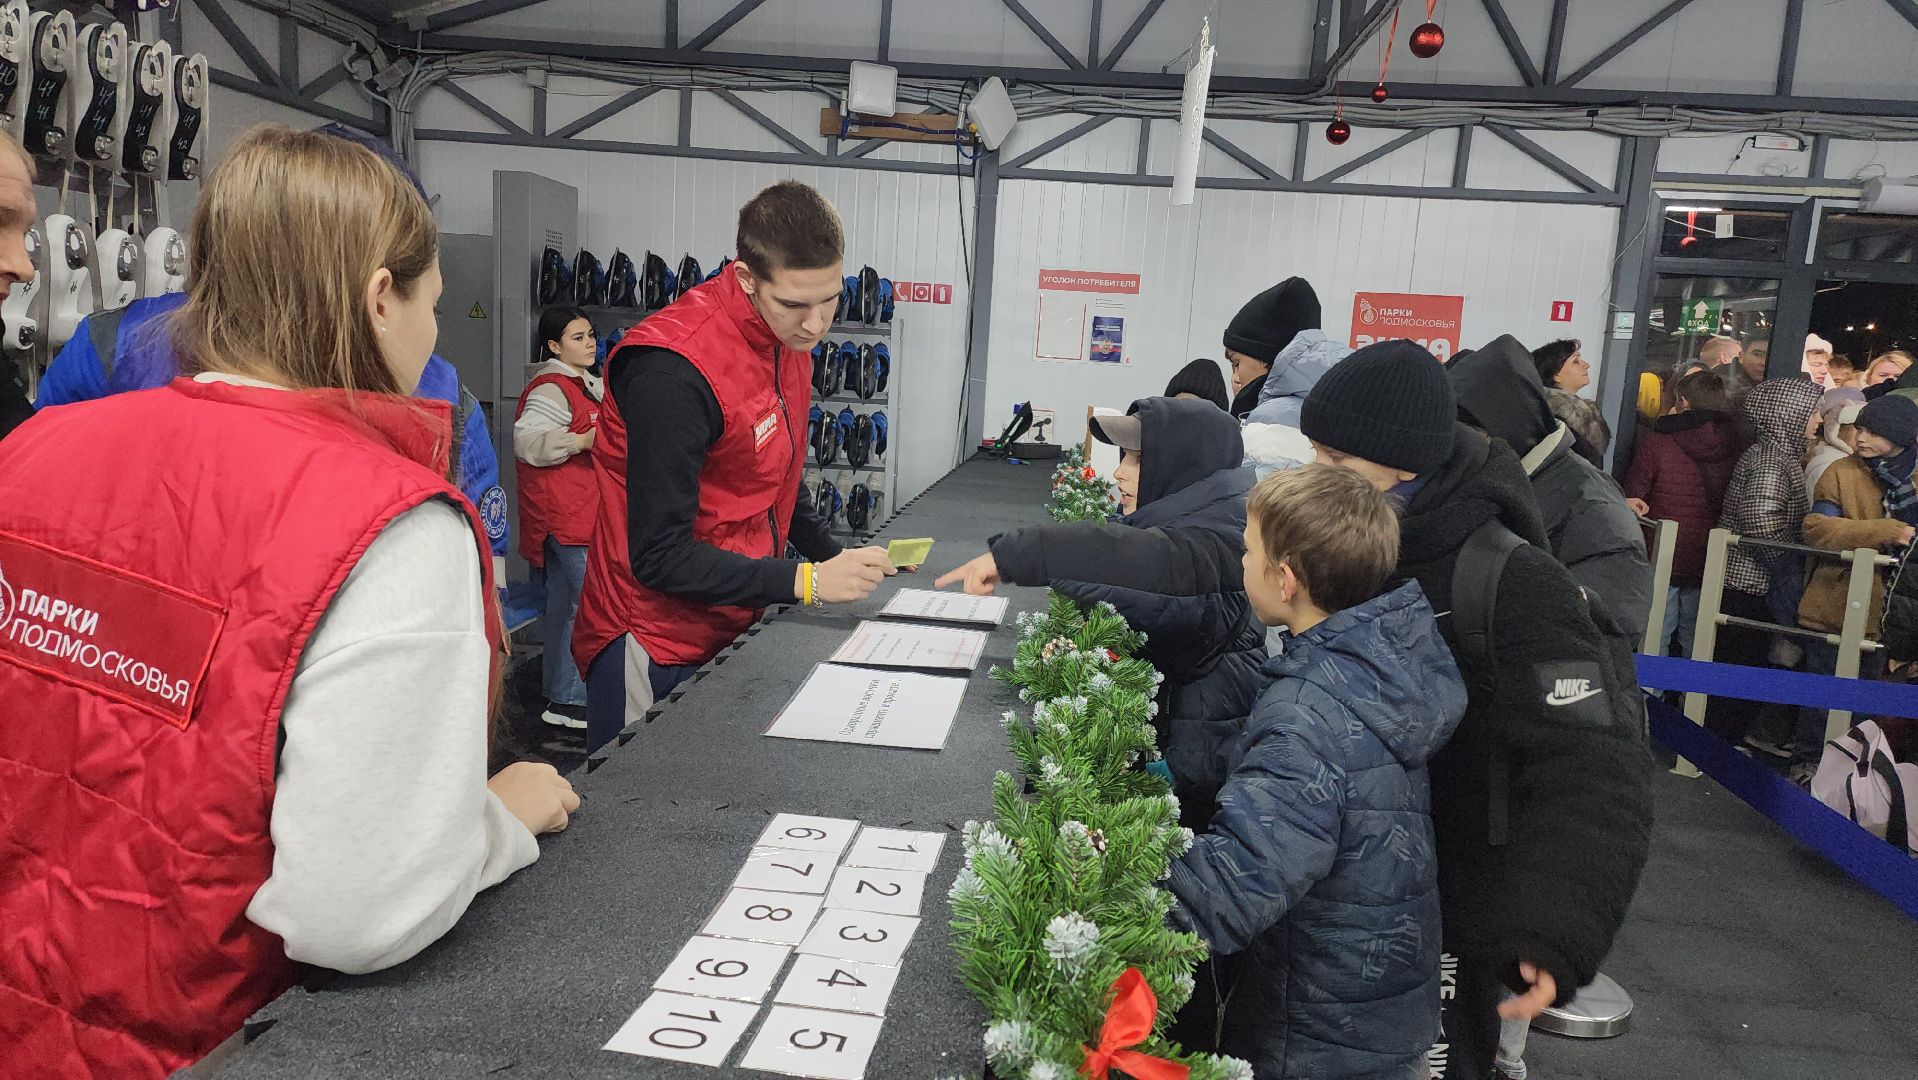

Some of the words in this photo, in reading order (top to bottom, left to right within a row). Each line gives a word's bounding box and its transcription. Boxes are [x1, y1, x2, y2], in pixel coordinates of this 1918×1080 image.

[1042, 275, 1077, 285] УГОЛОК
[1077, 278, 1137, 288] ПОТРЕБИТЕЛЯ
[1379, 308, 1413, 317] ПАРКИ
[1379, 317, 1456, 329] ПОДМОСКОВЬЯ
[1687, 319, 1710, 328] ВХОД
[19, 588, 99, 636] ПАРКИ
[9, 617, 190, 707] ПОДМОСКОВЬЯ
[1554, 678, 1591, 698] NIKE
[876, 842, 919, 856] 1
[771, 861, 814, 878] 7
[856, 879, 901, 897] 2
[744, 904, 793, 922] 8
[838, 924, 888, 944] 3
[816, 968, 868, 988] 4
[1440, 952, 1459, 1000] NIKE
[648, 1009, 722, 1051] 10
[788, 1028, 848, 1053] 5
